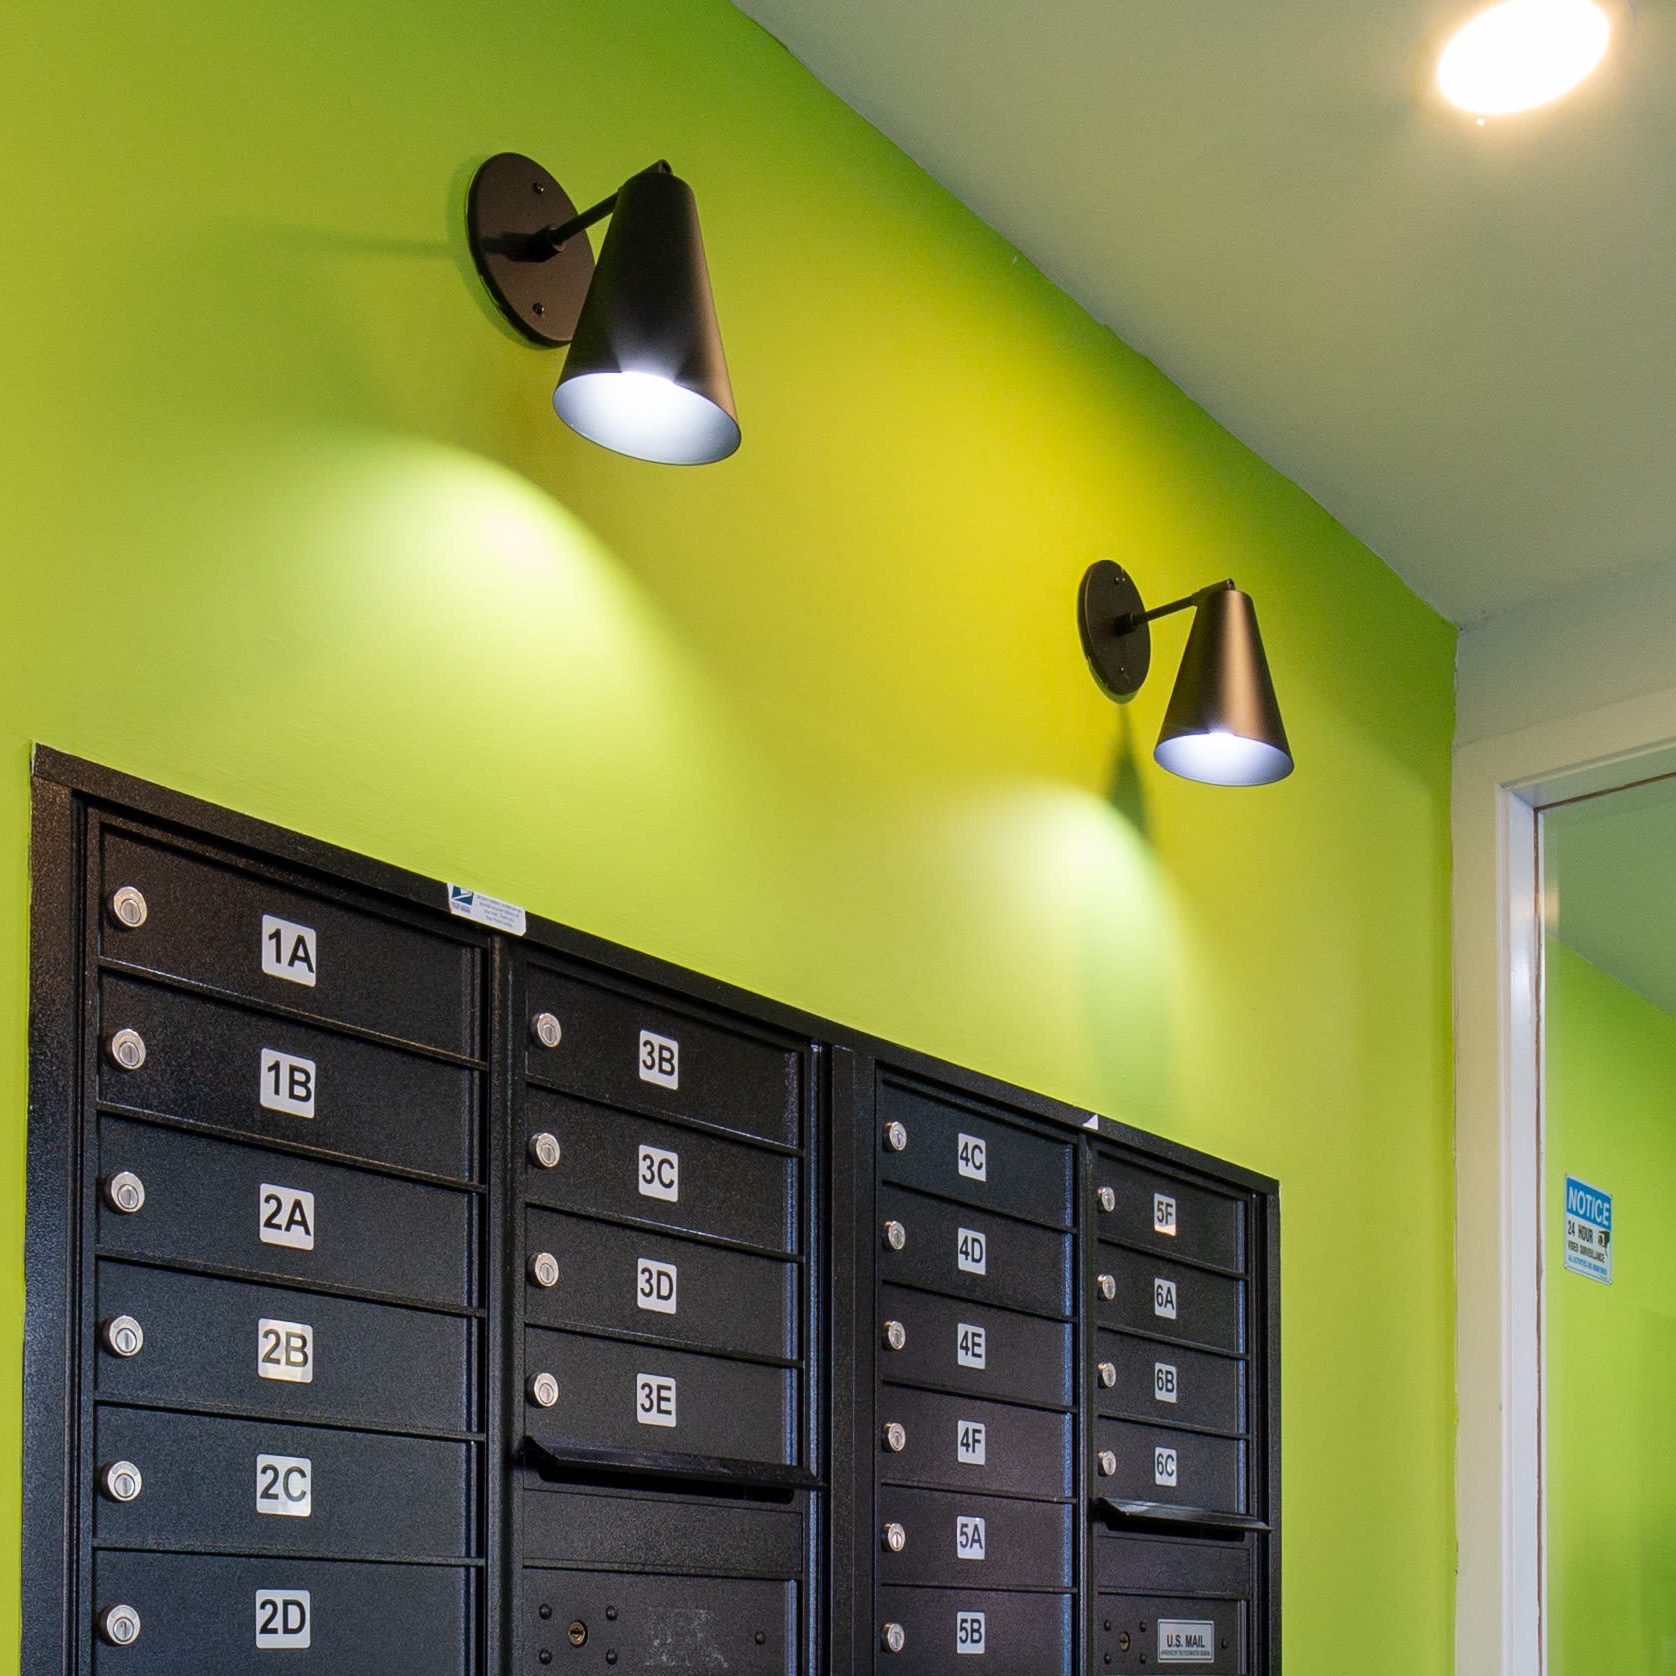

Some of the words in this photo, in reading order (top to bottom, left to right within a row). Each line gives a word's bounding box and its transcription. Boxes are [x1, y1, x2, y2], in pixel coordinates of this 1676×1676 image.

[268, 928, 315, 974] 1A
[642, 1039, 676, 1077] 3B
[267, 1060, 312, 1103] 1B
[641, 1153, 675, 1189] 3C
[959, 1141, 984, 1171] 4C
[263, 1193, 312, 1237] 2A
[1156, 1200, 1174, 1225] 5F
[1568, 1186, 1610, 1226] NOTICE
[1567, 1219, 1576, 1236] 24
[1578, 1223, 1594, 1244] HOUR
[959, 1235, 984, 1264] 4D
[639, 1266, 674, 1302] 3D
[1155, 1284, 1175, 1311] 6A
[261, 1328, 309, 1368] 2B
[959, 1330, 983, 1359] 4E
[1156, 1368, 1175, 1393] 6B
[640, 1382, 673, 1416] 3E
[959, 1426, 983, 1454] 4F
[1156, 1452, 1175, 1478] 6C
[259, 1463, 307, 1502] 2C
[959, 1522, 984, 1550] 5A
[258, 1598, 306, 1635] 2D
[958, 1618, 983, 1644] 5B
[1166, 1634, 1183, 1648] U.S.
[1185, 1634, 1206, 1648] MAIL
